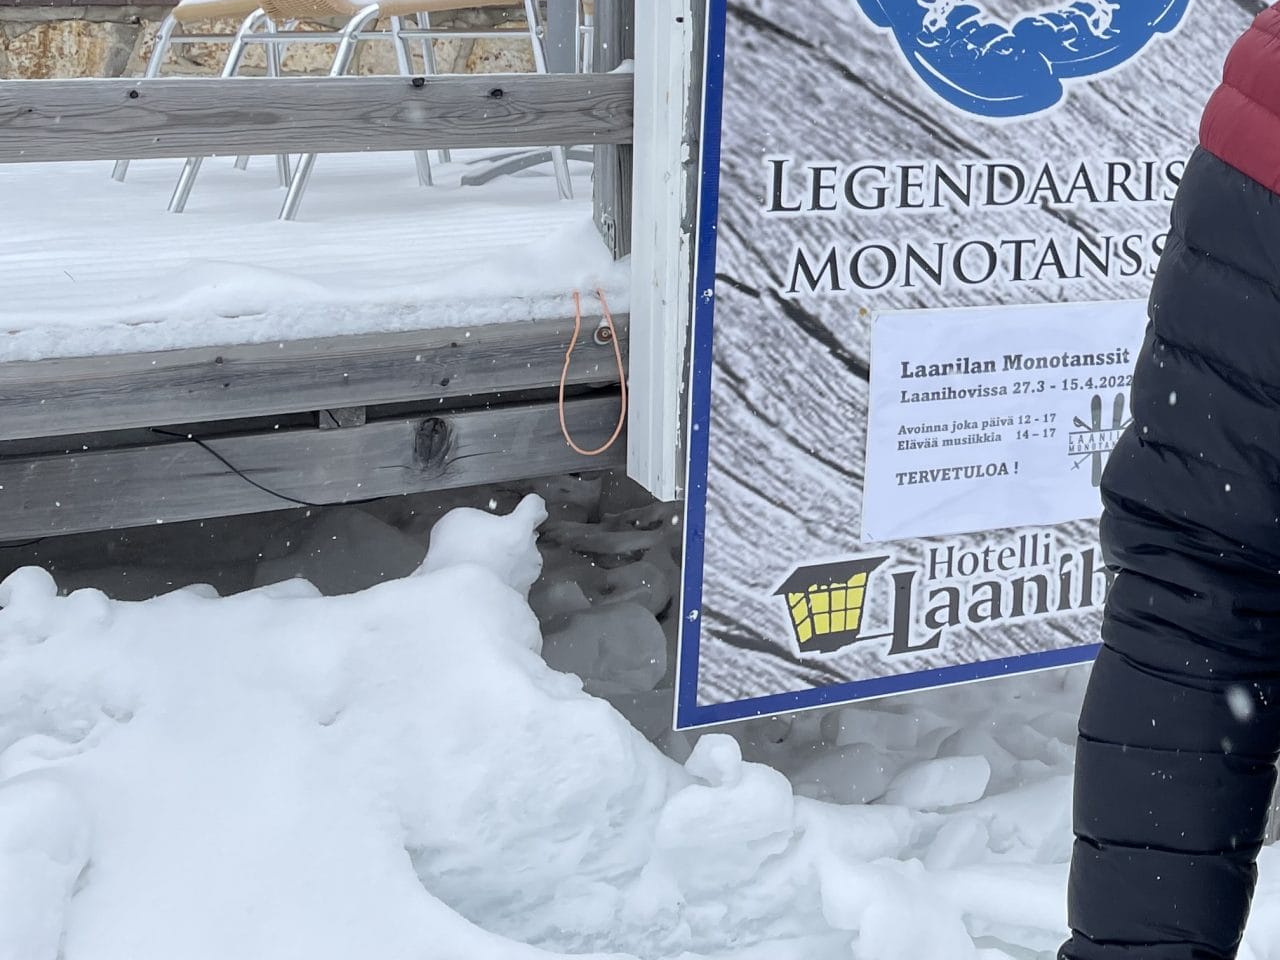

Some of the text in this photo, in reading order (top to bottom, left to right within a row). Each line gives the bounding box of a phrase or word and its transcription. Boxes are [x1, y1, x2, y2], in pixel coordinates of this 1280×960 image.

[766, 158, 1185, 213] LEGENDAARIS
[785, 233, 1168, 293] MONOTANSS
[900, 348, 1130, 379] Laanilan Monotanssit
[900, 385, 1007, 403] Laanihovissa
[1013, 380, 1045, 395] 27.3
[1062, 374, 1133, 391] 15.4.2022
[897, 423, 948, 436] Avoinna
[951, 418, 978, 434] joka
[981, 416, 1014, 432] päivä
[1018, 415, 1031, 425] 12
[1043, 413, 1056, 423] 17
[1069, 431, 1120, 445] LAANIL
[897, 437, 938, 451] Elävää
[942, 432, 1002, 447] musiikkia
[1016, 430, 1029, 440] 14
[1042, 429, 1056, 438] 17
[896, 462, 1009, 486] TERVETULOA
[929, 533, 1051, 580] Hotelli
[888, 548, 1114, 656] Laanih
